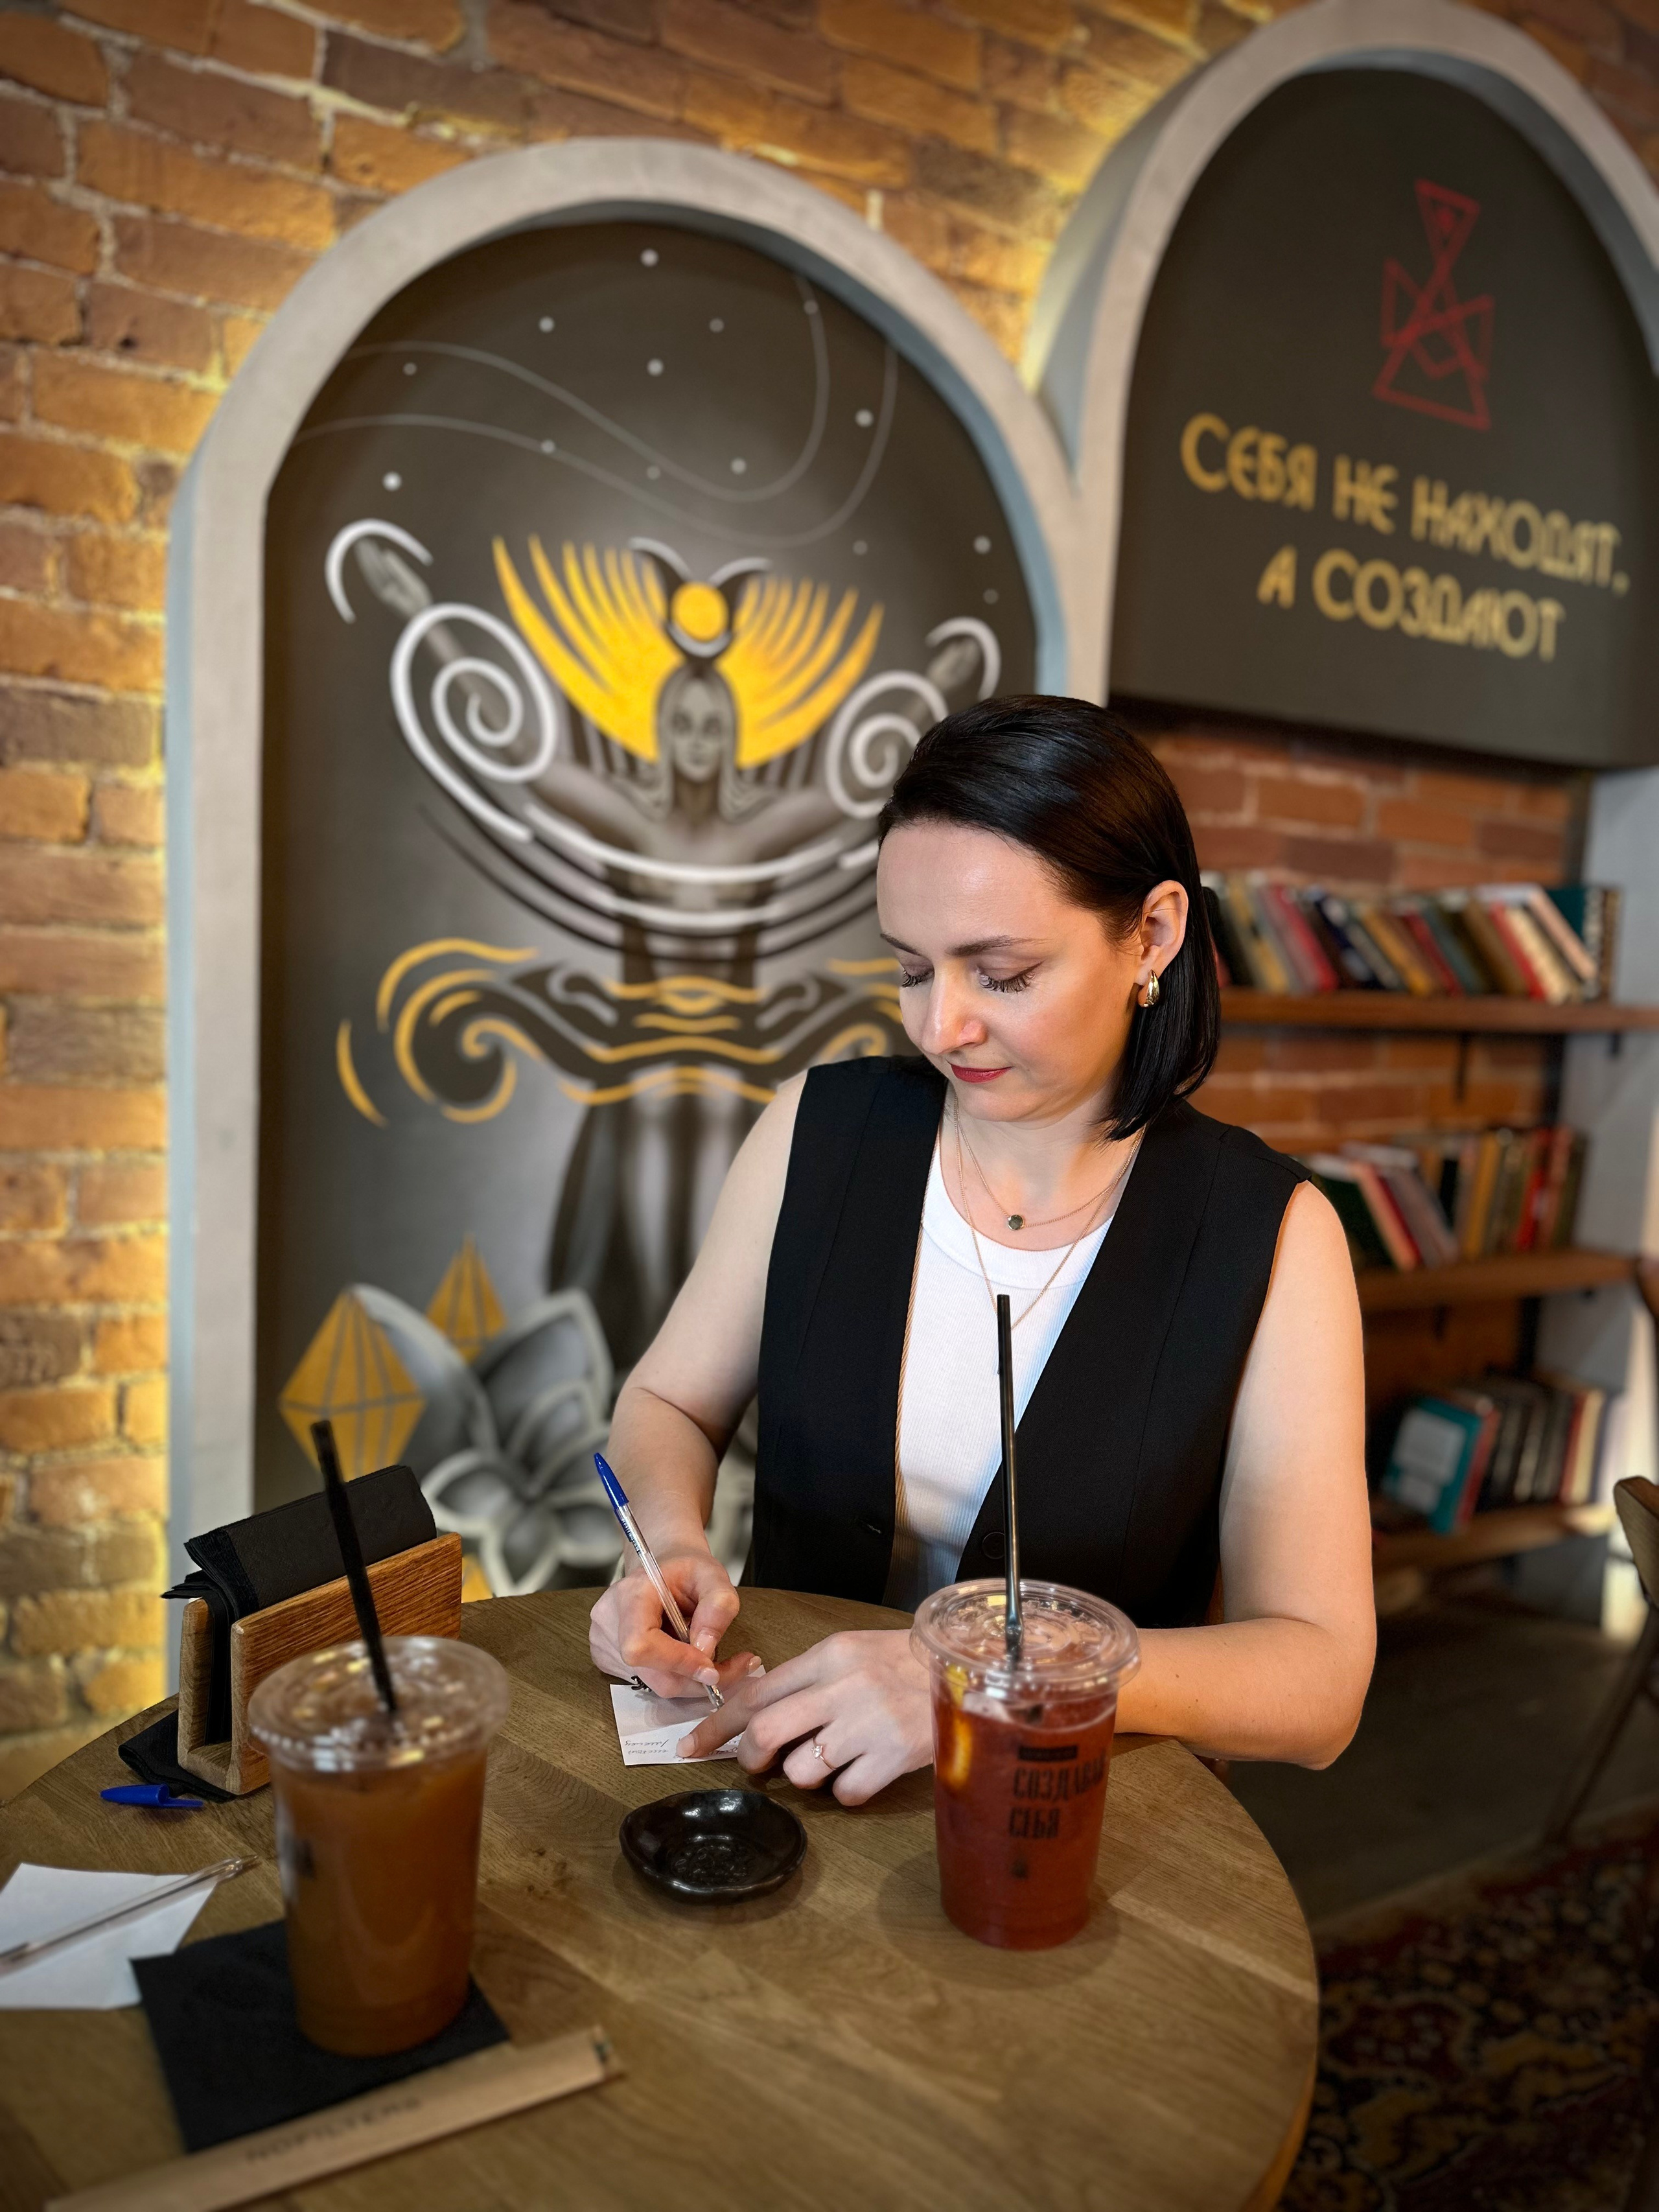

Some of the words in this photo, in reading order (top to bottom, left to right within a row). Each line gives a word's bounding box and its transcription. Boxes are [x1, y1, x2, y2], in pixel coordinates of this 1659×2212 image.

[1180, 412, 1318, 512] СЕБЯ
[1332, 454, 1400, 535] НЕ
[1257, 544, 1297, 609] А
[1312, 548, 1566, 664] СОЗДАЮТ
